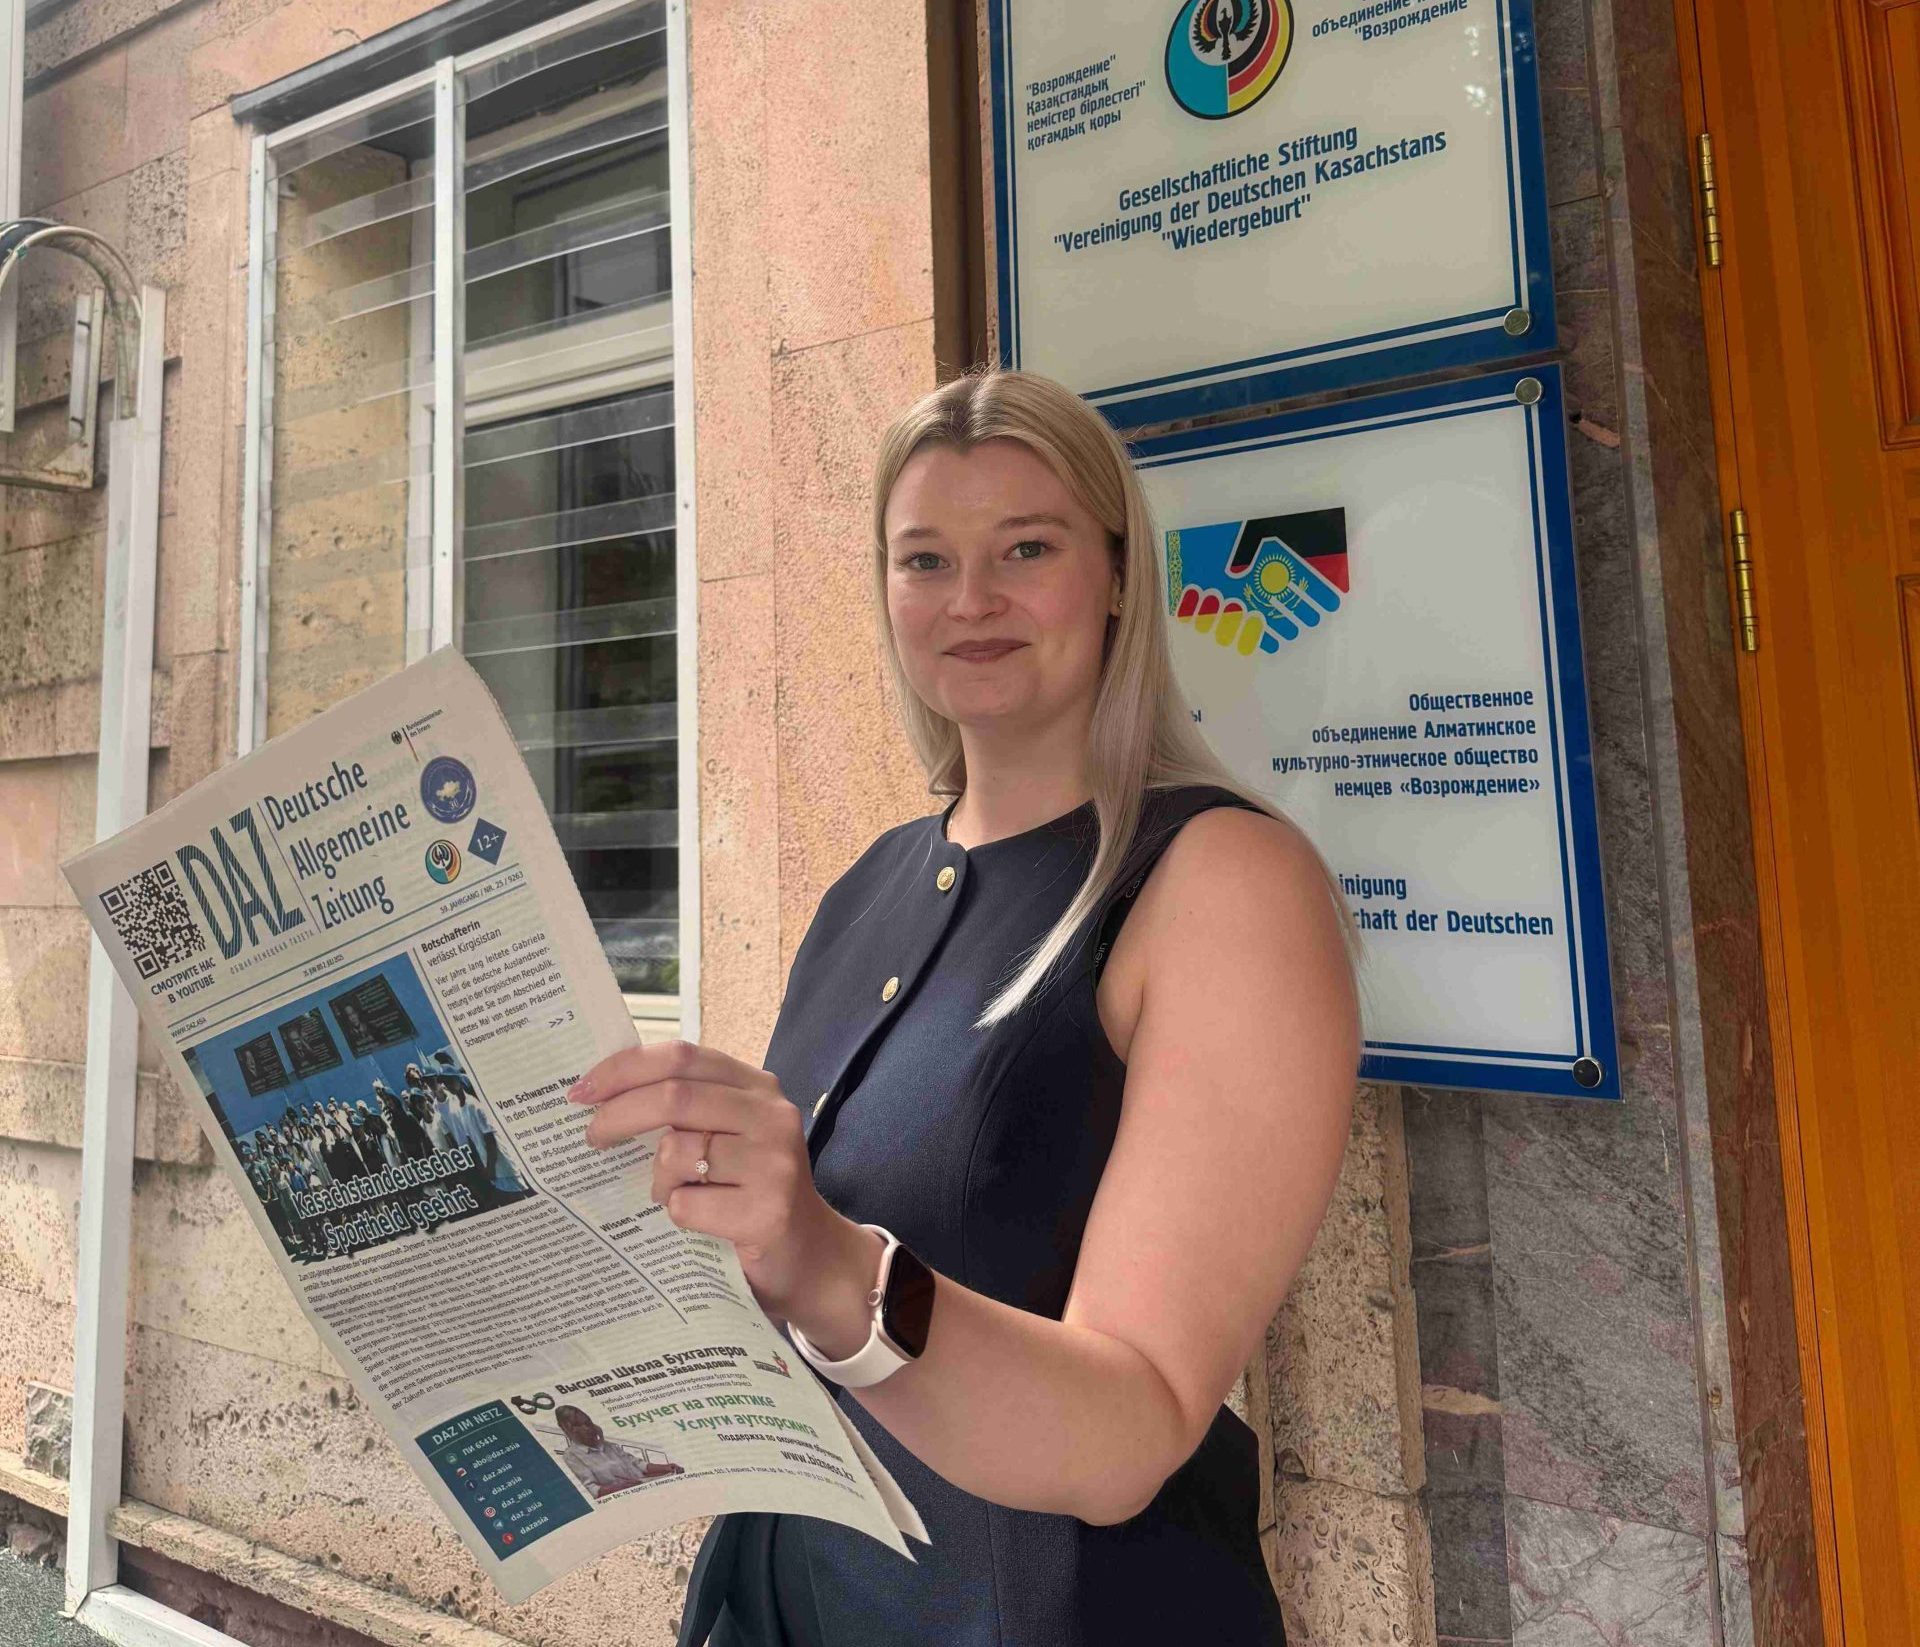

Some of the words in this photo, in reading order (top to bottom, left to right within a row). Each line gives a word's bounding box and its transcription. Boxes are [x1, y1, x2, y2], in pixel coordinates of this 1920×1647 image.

[1026, 54, 1116, 97] "Возрождение"
[1026, 78, 1109, 116] Қазақстандық
[1027, 107, 1076, 133] немістер
[1080, 80, 1146, 115] бірлестегі"
[1027, 122, 1086, 151] қоғамдық
[1090, 110, 1121, 131] қоры
[1119, 153, 1270, 211] Gesellschaftliche
[1278, 126, 1358, 166] Stiftung
[1054, 210, 1162, 252] "Vereinigung
[1170, 199, 1201, 224] der
[1208, 170, 1307, 214] Deutschen
[1315, 131, 1447, 184] Kasachstans
[1162, 193, 1312, 250] "Wiedergeburt"
[1408, 690, 1534, 712] Общественное
[1312, 724, 1417, 744] объединение
[1424, 719, 1537, 739] Алматинское
[1272, 750, 1448, 775] культурно-этническое
[1454, 747, 1539, 767] общество
[265, 762, 367, 830] Deutsche
[1334, 780, 1393, 798] немцев
[1400, 777, 1541, 798] «Возрождение»
[291, 805, 410, 879] Allgemeine
[477, 834, 499, 851] 12+
[178, 811, 303, 958] DAZ
[312, 877, 394, 929] Zeitung
[422, 922, 480, 952] Botschafterin
[1405, 909, 1439, 931] der
[1447, 910, 1554, 935] Deutschen
[428, 948, 457, 967] verlässt
[458, 929, 501, 953] Kirgisistan
[435, 976, 448, 985] Vier
[450, 968, 467, 981] Jahre
[468, 960, 484, 971] lang
[486, 949, 509, 963] leitete
[512, 934, 545, 952] Gabriela
[152, 966, 199, 995] СМОТРИТЕ
[199, 958, 216, 972] НАС
[462, 981, 471, 989] die
[473, 968, 501, 985] deutsche
[504, 948, 550, 971] Auslandsver-
[176, 975, 215, 999] YOUTUBE
[505, 1002, 528, 1016] dessen
[530, 985, 566, 1006] Präsident
[514, 978, 546, 997] Abschied
[549, 973, 561, 982] ein
[567, 1011, 574, 1021] 3
[496, 1099, 516, 1110] Vom
[516, 1084, 559, 1103] Schwarzen
[558, 1075, 580, 1087] Meer
[513, 1110, 528, 1120] den
[527, 1097, 568, 1115] Bundestag
[291, 1145, 475, 1219] Kasachstandeutscher
[323, 1203, 407, 1253] Sportheld
[408, 1185, 477, 1231] geehrt
[600, 1217, 636, 1232] Wissen,
[636, 1205, 663, 1218] woher
[610, 1226, 642, 1241] kommt
[556, 1374, 612, 1394] Высшая
[612, 1360, 664, 1378] Школа
[663, 1347, 747, 1365] Бухгалтеров
[432, 1426, 458, 1445] DAZ
[458, 1419, 474, 1431] IM
[473, 1408, 502, 1424] NETZ
[612, 1404, 679, 1427] Бухучет
[682, 1400, 704, 1411] на
[706, 1395, 775, 1408] практике
[674, 1416, 733, 1431] Услуги
[735, 1415, 818, 1438] аутсорсинга
[473, 1443, 520, 1468] abo@daz.asia
[483, 1464, 512, 1482] daz.asia
[492, 1477, 522, 1495] daz.asia
[502, 1489, 533, 1508] daz_asia
[511, 1502, 543, 1521] daz_asia
[520, 1516, 549, 1534] dazasia
